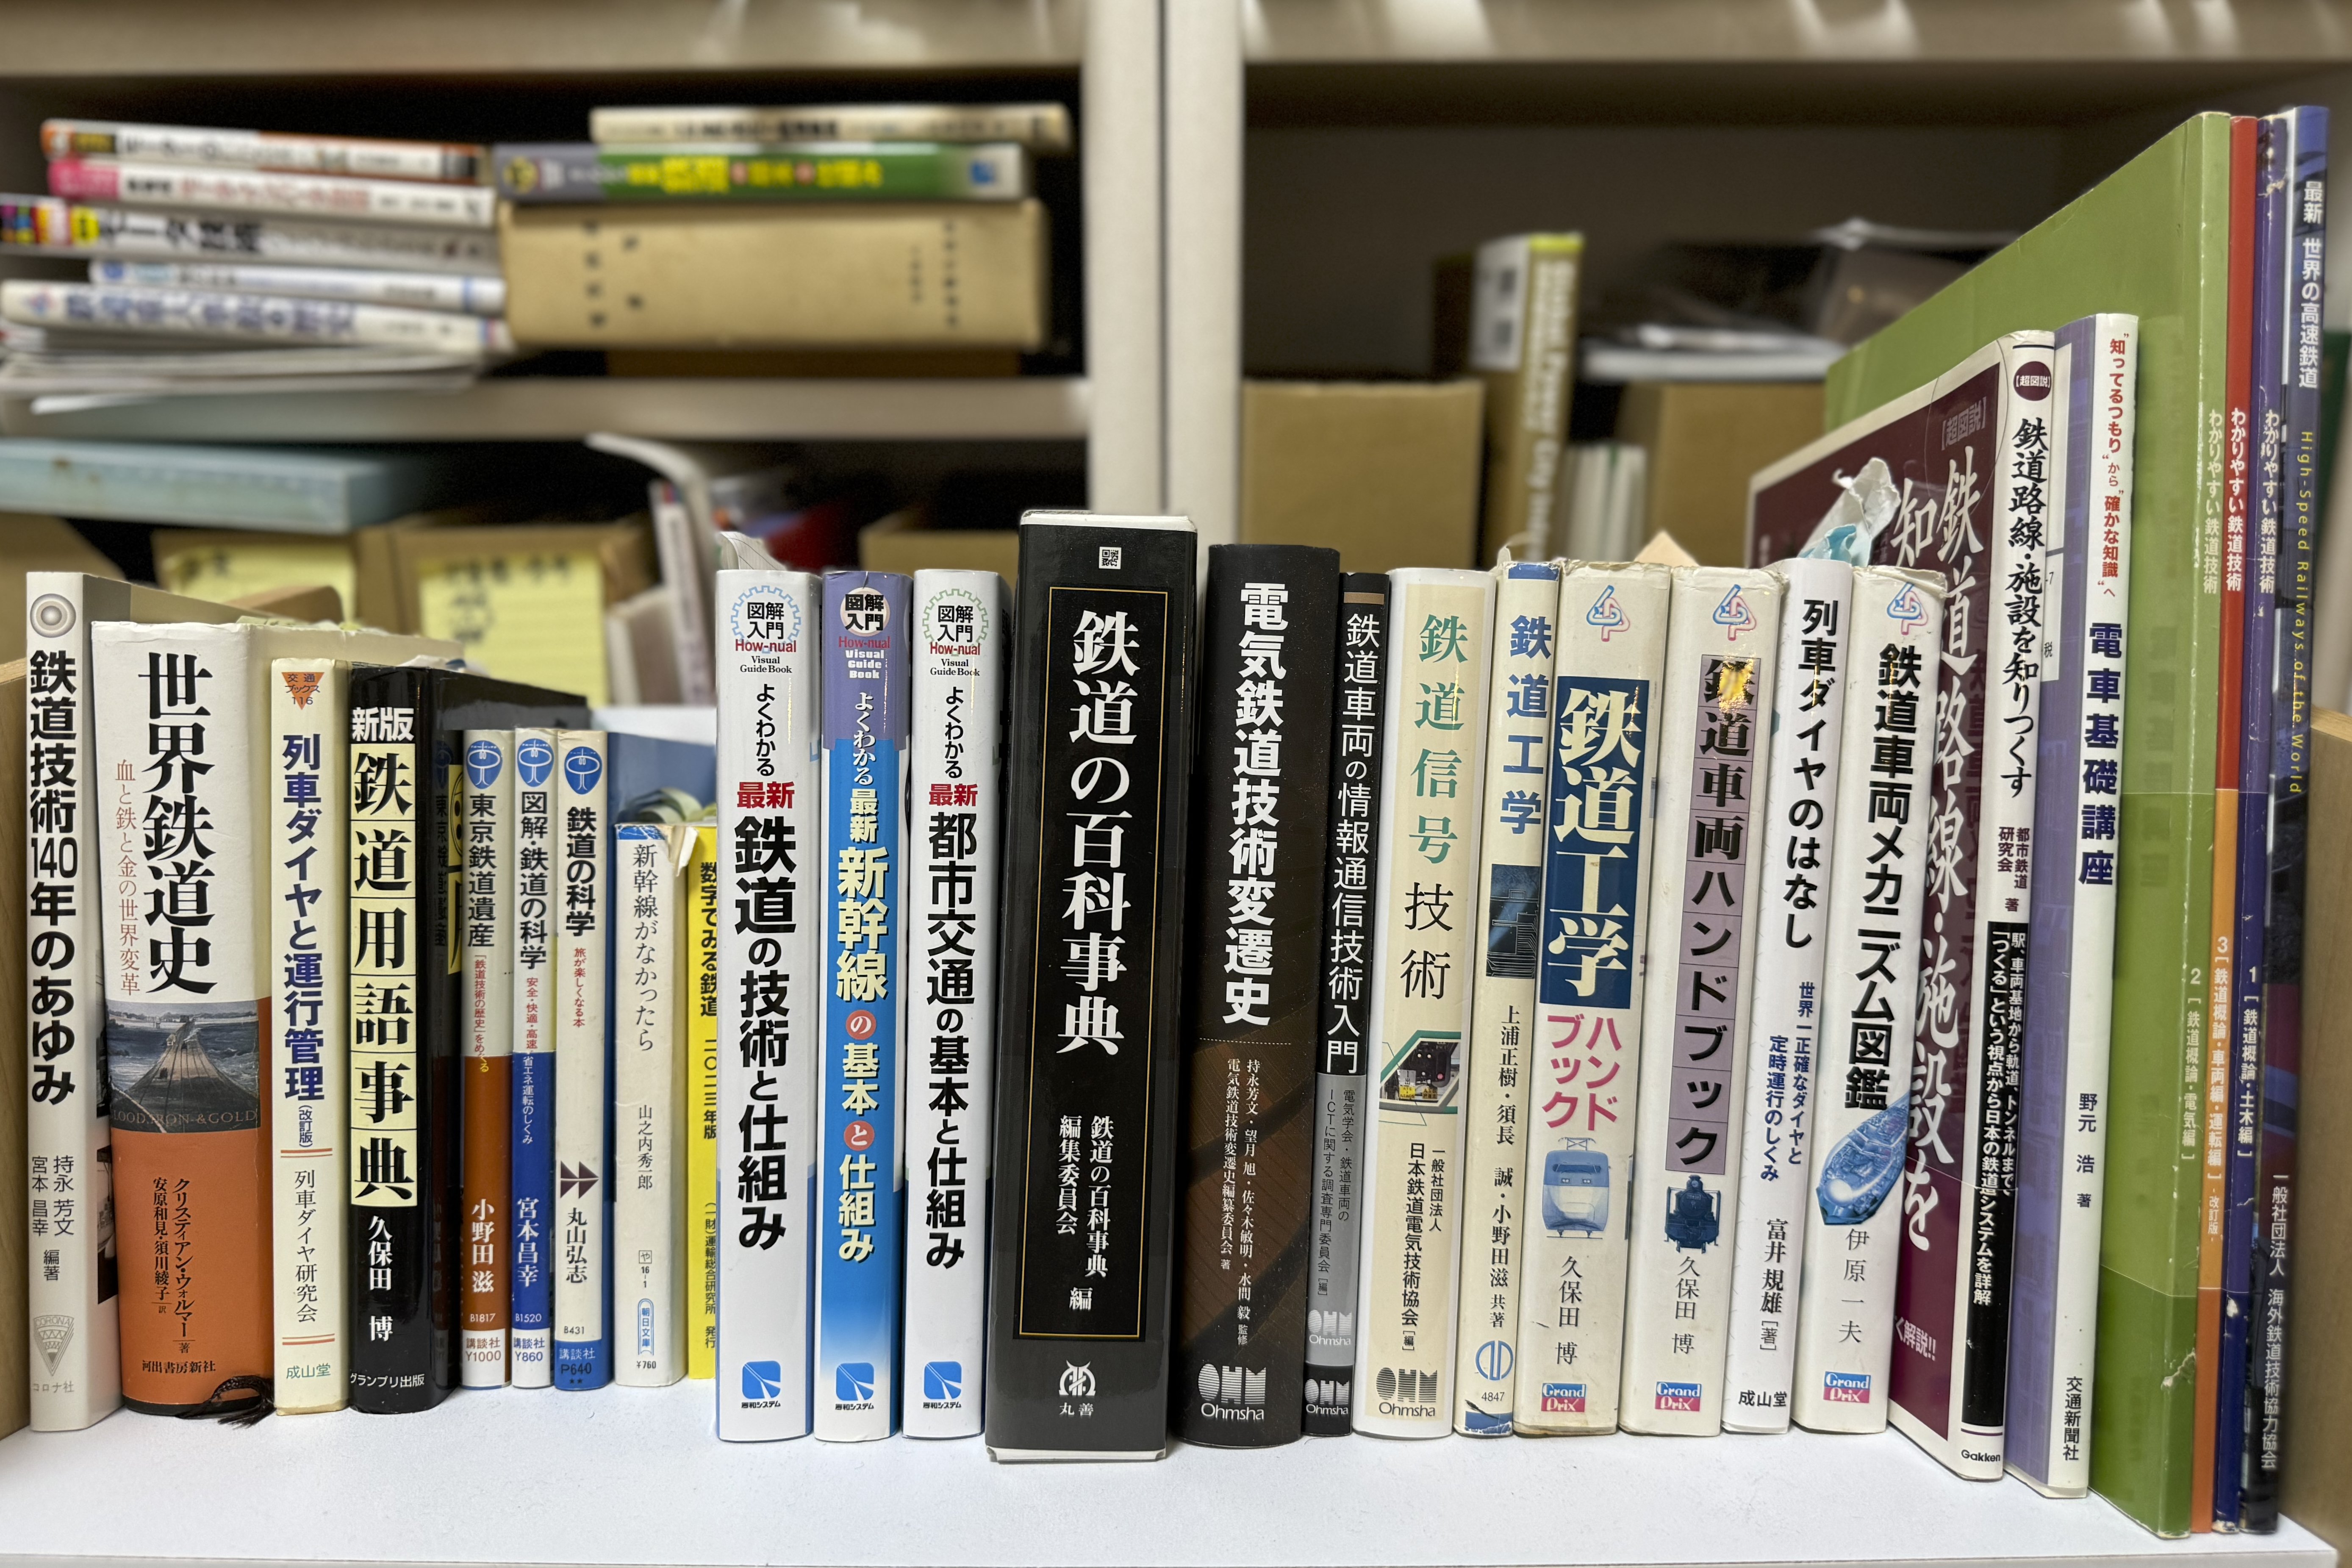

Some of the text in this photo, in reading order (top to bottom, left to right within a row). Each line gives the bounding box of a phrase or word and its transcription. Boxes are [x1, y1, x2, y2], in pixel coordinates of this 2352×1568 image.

[2299, 181, 2323, 389] 最新 世界の高速鉄道
[2203, 409, 2223, 594] わかりやすい鉄道技術
[2226, 408, 2246, 591] わかりやすい鉄道技術
[2259, 409, 2280, 594] わかりやすい鉄道技術
[747, 602, 785, 620] 図解
[747, 622, 784, 639] 入門
[845, 594, 884, 612] 図解
[845, 613, 884, 631] 入門
[937, 605, 974, 624] 図解
[937, 624, 973, 643] 入門
[2000, 417, 2049, 798] 鉄道路線・施設を知りつくす
[2289, 431, 2313, 794] High-Speed Railways of the World
[735, 639, 796, 653] How-nual
[740, 665, 793, 674] Guide Book
[751, 656, 780, 664] Visual
[838, 636, 890, 649] How-nual
[845, 649, 885, 659] Visual
[848, 660, 882, 669] Guide
[849, 670, 880, 679] Book
[930, 641, 980, 655] How-nual
[930, 668, 980, 676] Guide Book
[941, 658, 969, 667] Visual
[285, 685, 321, 693] ブックス
[288, 673, 316, 683] 交通
[292, 697, 313, 705] 116
[352, 707, 415, 741] 新版
[737, 683, 795, 809] よくわかる 最新
[929, 686, 978, 807] よくわかる 最新
[1500, 615, 1552, 834] 鉄道工学
[2078, 622, 2122, 885] 電車基礎講座
[850, 692, 879, 843] よくわかる 最新
[1782, 599, 1838, 949] 列車ダイヤのはなし
[138, 652, 218, 994] 世界鉄道史
[1056, 610, 1141, 1056] 鉄道の百科事典
[1222, 582, 1289, 1026] 電気鉄道技術変遷史
[1400, 614, 1468, 1000] 鉄道信号技術
[30, 649, 78, 1105] 鉄道技術140年のあゆみ
[468, 793, 497, 947] 東京鉄道遺産
[566, 806, 596, 936] 鉄道の科学
[1326, 613, 1380, 1074] 鉄道車両の情報通信技術入門
[1548, 688, 1642, 997] 鉄道工学
[1844, 643, 1922, 1110] 鉄道車両メカニズム図鑑
[1997, 826, 2015, 873] 研究会
[2014, 827, 2030, 889] 都市鉄道
[116, 759, 140, 996] 血と鉄と金の世界変革
[520, 791, 549, 969] 図解・鉄道の科学
[2005, 898, 2019, 912] 著
[282, 733, 325, 1101] 列車ダイヤと運行管理
[632, 844, 659, 1051] 新幹線がなかったら
[700, 862, 717, 1017] 数字でみる鉄道
[2217, 936, 2228, 953] 3
[354, 752, 415, 1200] 鉄道用語事典
[573, 947, 586, 1028] 旅が楽しくなる本
[2190, 968, 2201, 985] 2
[2249, 966, 2257, 983] 1
[474, 954, 490, 1072] 「鉄道技術の歴史」をめぐる
[734, 816, 797, 1250] 鉄道の技術と仕組み
[926, 812, 977, 1269] 都市交通の基本と仕組み
[836, 846, 890, 1263] 新幹線の基本と仕組み
[1542, 1013, 1585, 1128] ブック
[1585, 1017, 1622, 1131] ハンド
[1788, 981, 1815, 1165] 世界一正確なダイヤと
[208, 1110, 257, 1124] GOLD
[704, 1039, 717, 1140] 二〇二三年版
[1760, 1035, 1789, 1181] 定時運行のしくみ
[638, 1105, 653, 1190] 山之内秀一郎
[1056, 1115, 1082, 1235] 編集委員会
[1220, 1058, 1240, 1255] 電気鉄道技術変遷史編纂委員会
[1317, 1089, 1335, 1273] ICTに関する調査専門委員会
[1338, 1090, 1355, 1221] 電気学会・鉄道車両の
[2076, 1093, 2097, 1208] 野元 浩 著
[32, 1155, 49, 1237] 宮本 昌幸
[53, 1155, 75, 1236] 持永 芳文
[1085, 1116, 1115, 1278] 鉄道の百科事典
[1428, 1150, 1445, 1232] 一般社団法人
[44, 1249, 60, 1281] 編著
[153, 1177, 169, 1301] 安原和見・須川綾子
[172, 1178, 195, 1354] クリスティアン・ウォルマー 著
[294, 1169, 318, 1323] 列車ダイヤ研究会
[472, 1198, 495, 1293] 小野田滋
[516, 1197, 539, 1288] 宮本昌幸
[566, 1207, 588, 1284] 丸山弘志
[1401, 1143, 1426, 1327] 日本鉄道電気技術協会
[368, 1215, 394, 1342] 久保田 博
[1069, 1287, 1093, 1312] 編
[1489, 1294, 1506, 1328] 共著
[1555, 1255, 1582, 1365] 久保田 博
[1671, 1256, 1700, 1354] 久保田 博
[1838, 1228, 1869, 1343] 伊原一夫
[34, 1316, 71, 1327] CORONA
[466, 1337, 501, 1349] 講談社
[470, 1314, 496, 1323] B1817
[513, 1337, 545, 1349] 講談社
[516, 1314, 542, 1323] B1520
[564, 1327, 585, 1335] B431
[642, 1307, 650, 1347] 朝日文庫
[705, 1326, 716, 1349] 発行
[1309, 1335, 1351, 1346] Ohmsha
[2261, 1174, 2289, 1469] 一般社団法人 海外鉄道技術協力協会
[33, 1380, 74, 1393] コロナ社
[142, 1360, 216, 1374] 河出書房新社
[286, 1363, 331, 1379] 成山堂
[350, 1373, 425, 1388] グランプリ出版
[466, 1351, 501, 1362] Y1000
[515, 1351, 543, 1362] Y860
[559, 1348, 596, 1360] 講談社
[560, 1363, 592, 1376] P640
[636, 1360, 656, 1369] ¥760
[1825, 1373, 1870, 1389] Grand
[1059, 1402, 1094, 1418] 丸善
[1201, 1402, 1265, 1421] Ohmsha
[1306, 1404, 1349, 1415] Ohmsha
[1378, 1401, 1436, 1417] Ohmsha
[1481, 1391, 1505, 1402] 4847
[1542, 1383, 1586, 1398] Grand
[1546, 1398, 1579, 1411] Prix
[1656, 1382, 1702, 1397] Grand
[1660, 1396, 1694, 1410] Prix
[1738, 1389, 1787, 1407] 成山堂
[1829, 1387, 1863, 1402] Prix
[2063, 1376, 2083, 1461] 交通新聞社
[1961, 1449, 2001, 1462] Gakken
